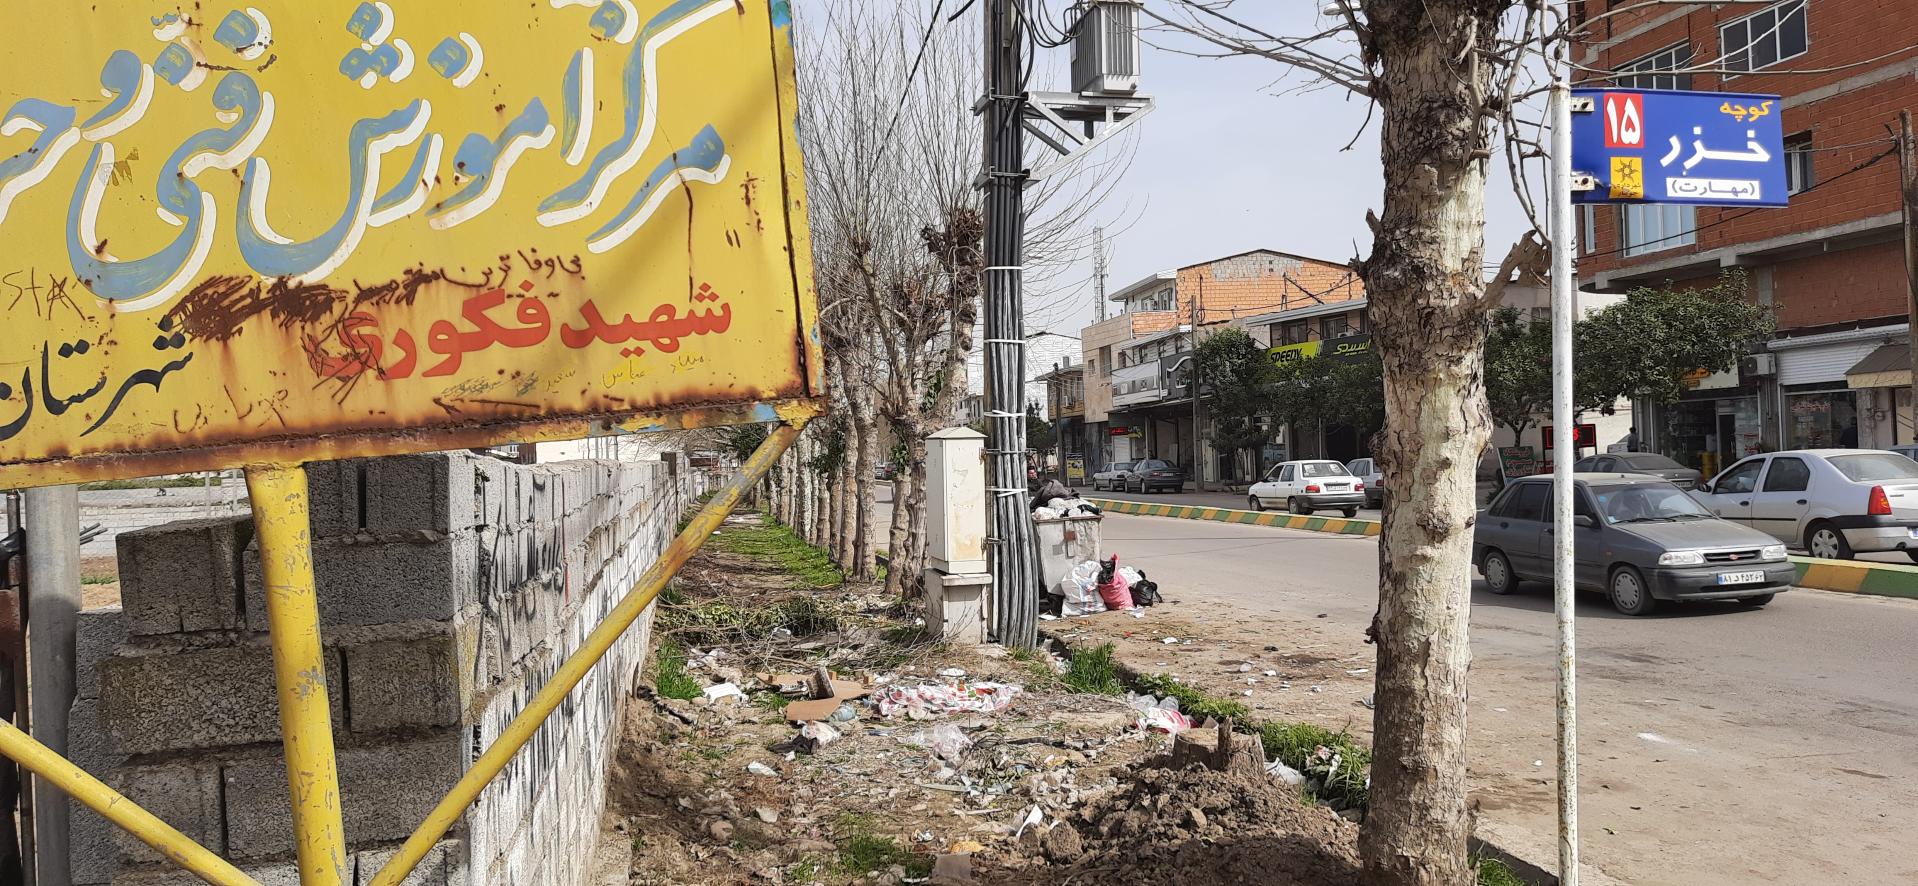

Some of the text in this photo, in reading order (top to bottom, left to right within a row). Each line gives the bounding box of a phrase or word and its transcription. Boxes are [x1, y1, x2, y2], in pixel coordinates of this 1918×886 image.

[81, 49, 154, 142] و
[537, 0, 731, 254] مرکز
[1606, 96, 1641, 145] ۱۵
[1719, 101, 1773, 122] کوچه
[1659, 126, 1771, 171] خزر
[1671, 179, 1756, 196] (مهارت)
[306, 279, 551, 381] فکوری
[560, 281, 732, 358] شهید
[0, 314, 194, 442] شهرستان
